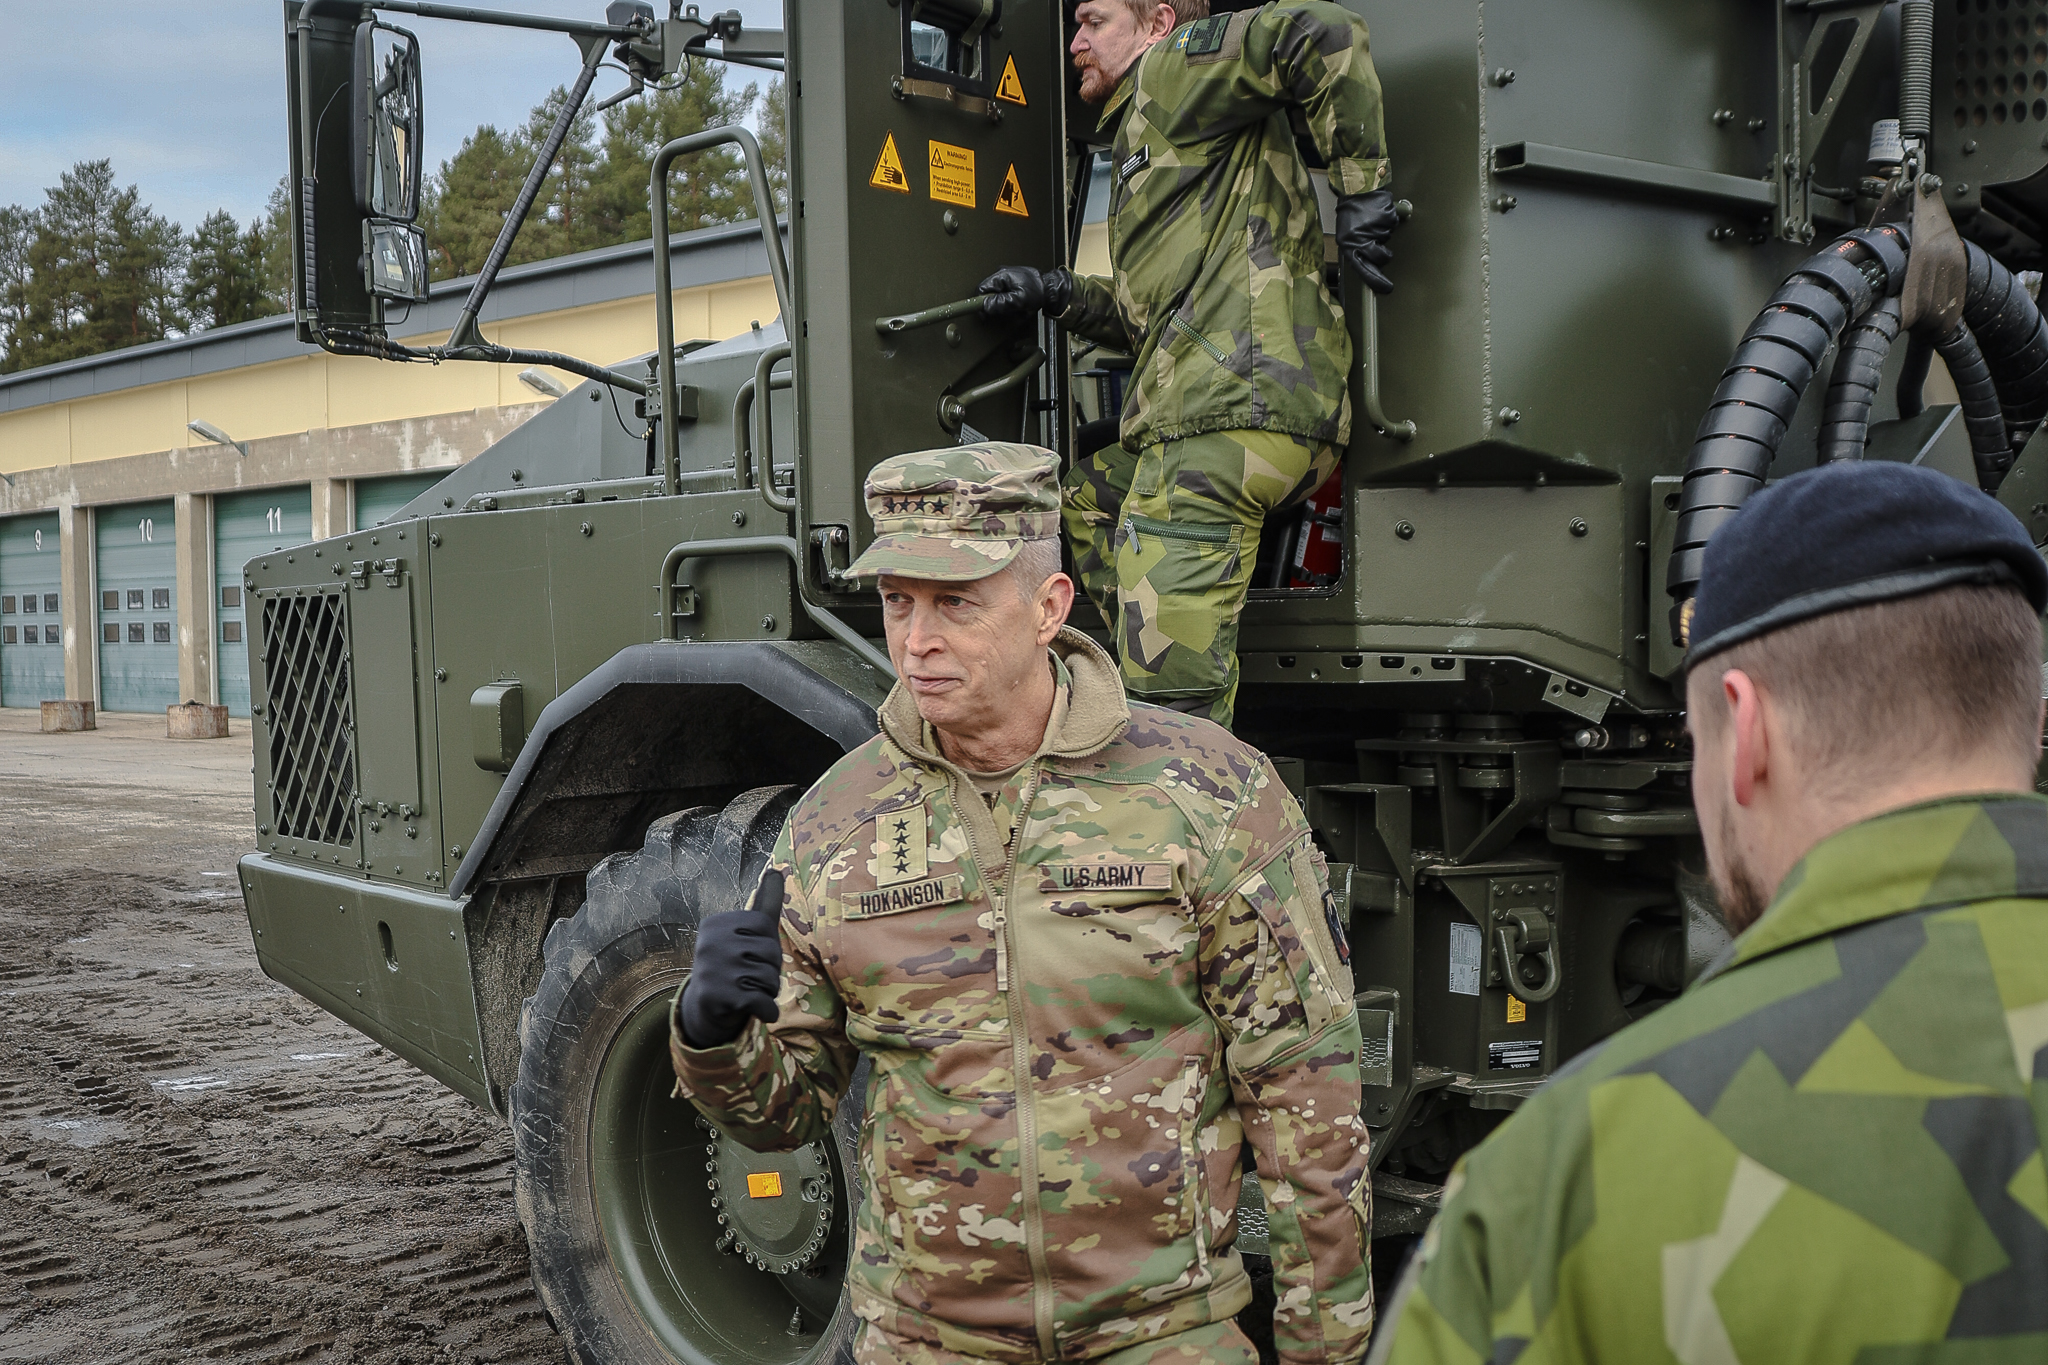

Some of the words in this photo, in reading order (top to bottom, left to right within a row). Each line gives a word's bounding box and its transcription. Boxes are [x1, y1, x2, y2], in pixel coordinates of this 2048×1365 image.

[1838, 240, 1857, 252] HYD
[138, 518, 153, 542] 10
[266, 507, 282, 533] 11
[34, 529, 42, 550] 9
[860, 880, 945, 914] HOKANSON
